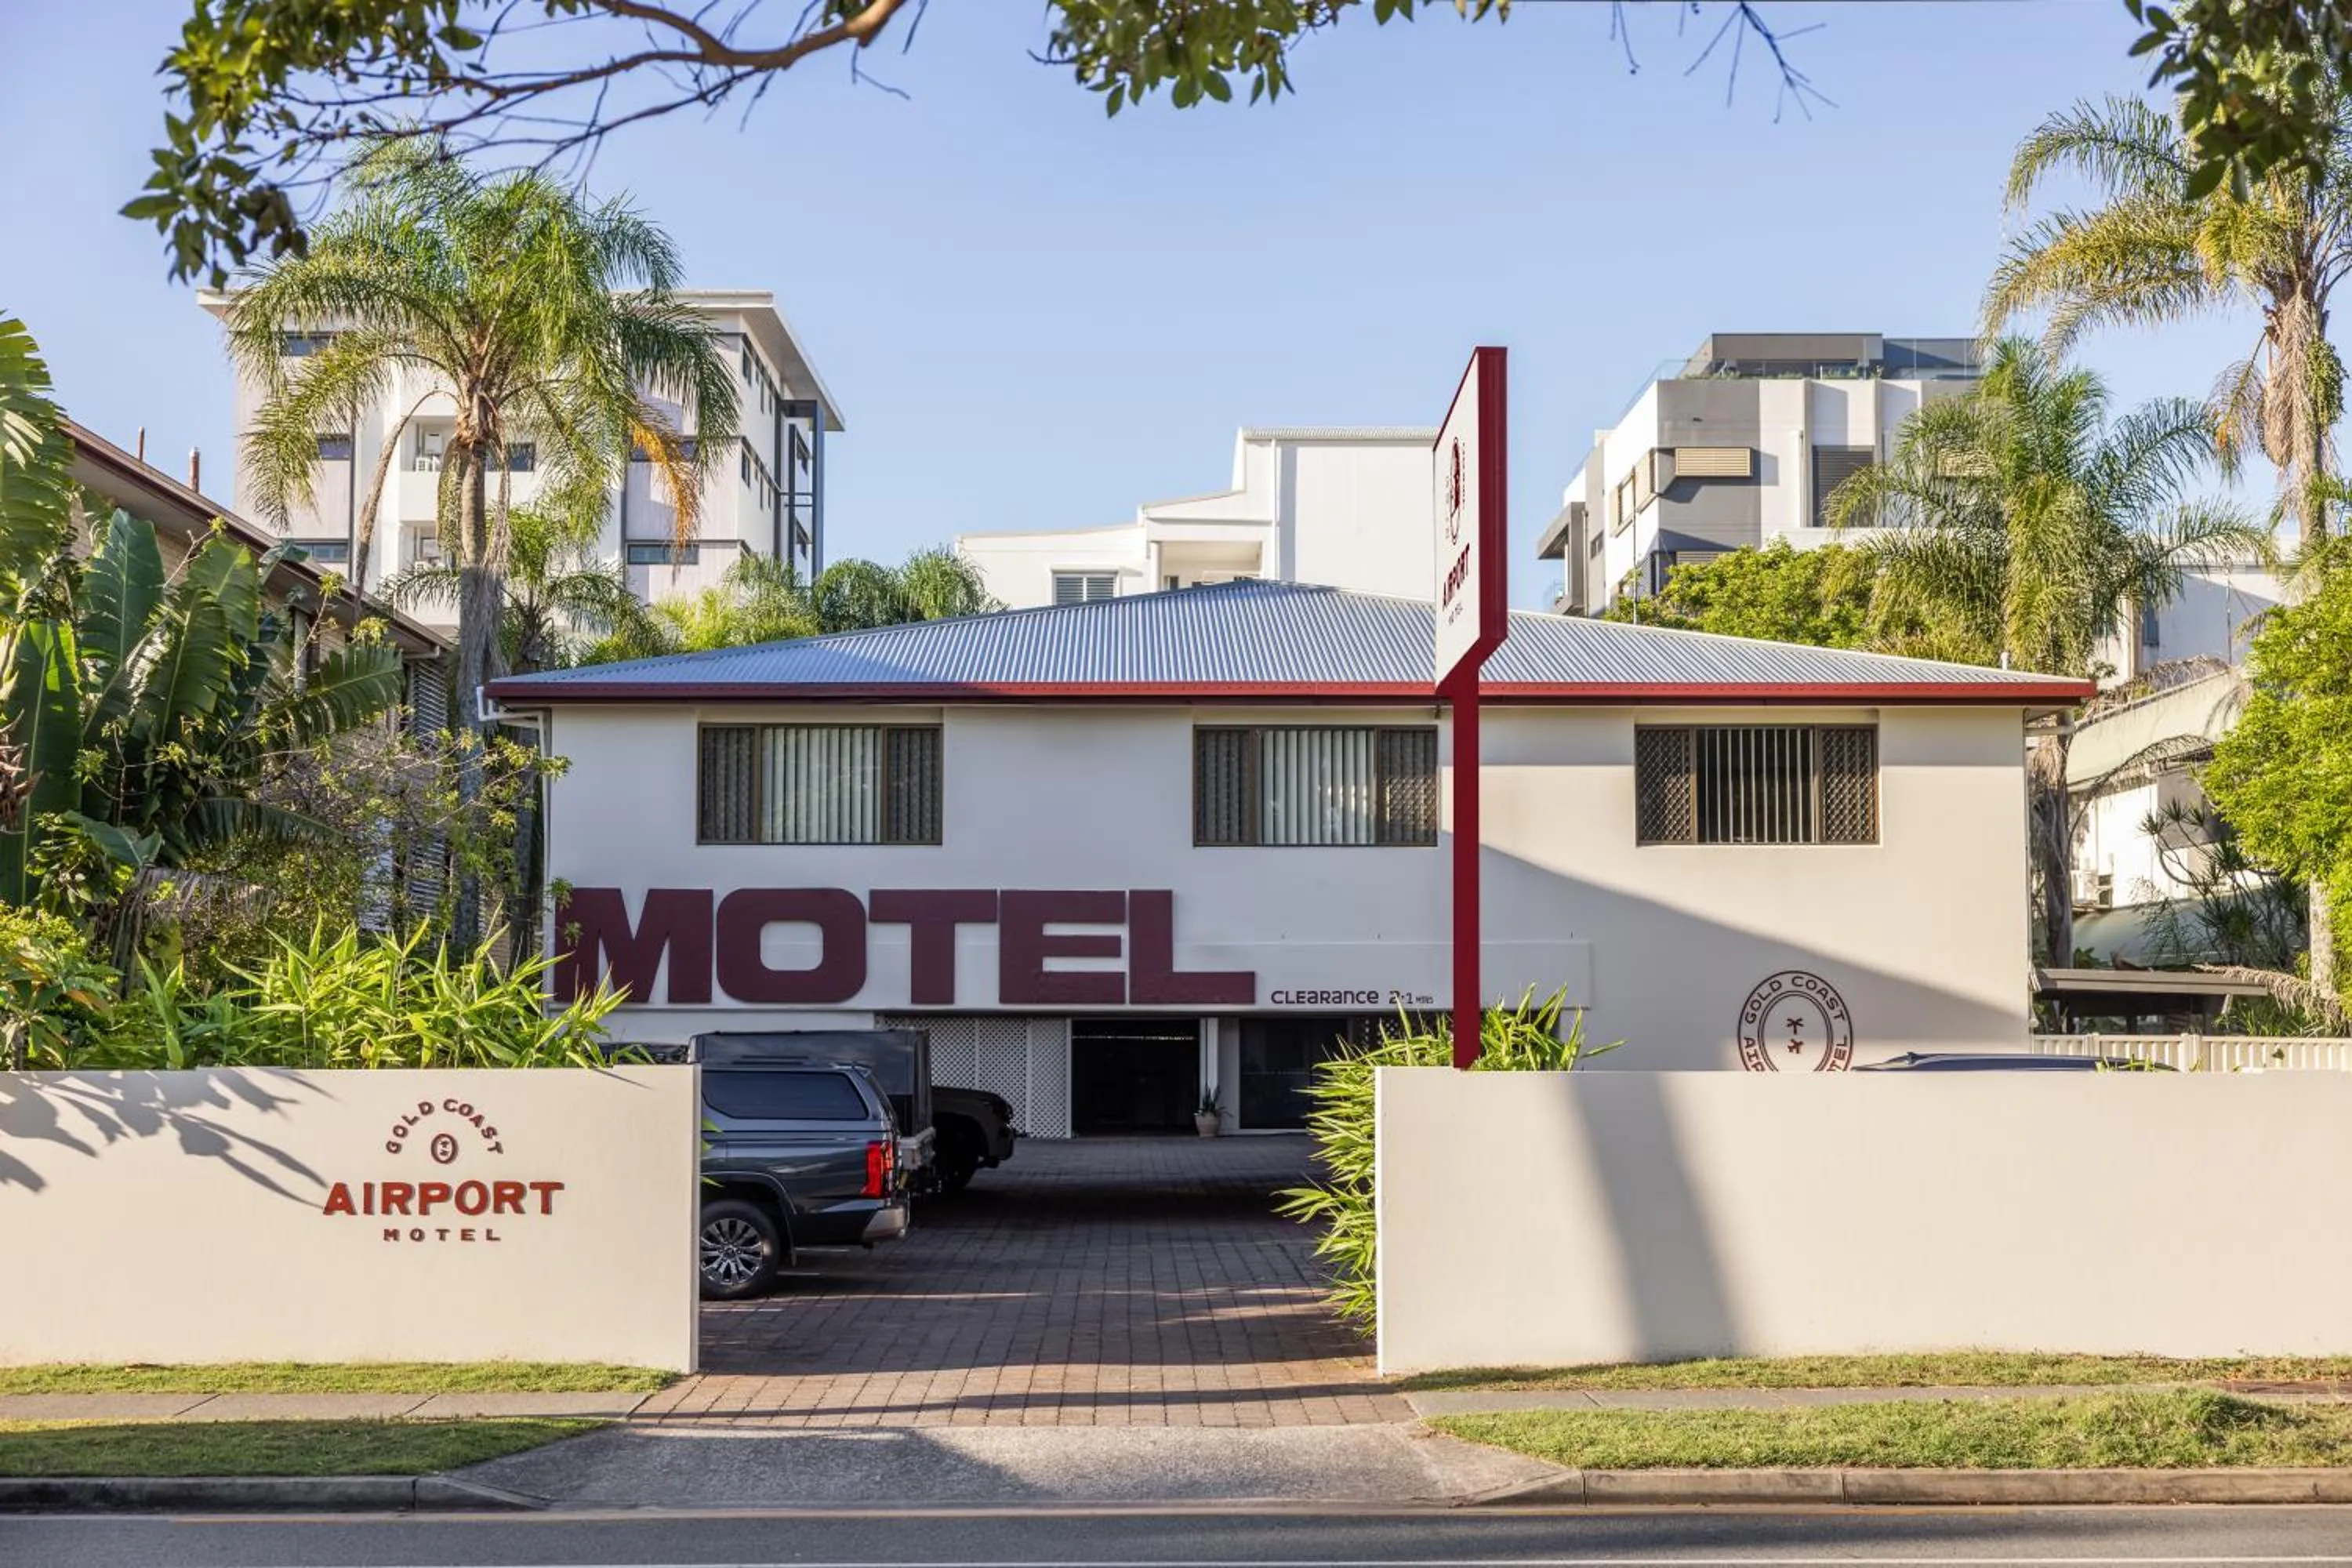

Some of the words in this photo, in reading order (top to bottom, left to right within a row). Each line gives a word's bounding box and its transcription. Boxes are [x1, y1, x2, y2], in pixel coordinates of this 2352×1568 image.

[554, 887, 1255, 1004] MOTEL
[1744, 980, 1782, 1025] GOLD
[1791, 976, 1846, 1022] COAST
[1826, 1034, 1848, 1072] TEL
[385, 1101, 435, 1155] GOLD
[443, 1098, 504, 1155] COAST
[322, 1179, 565, 1216] AIRPORT
[383, 1228, 502, 1242] MOTEL
